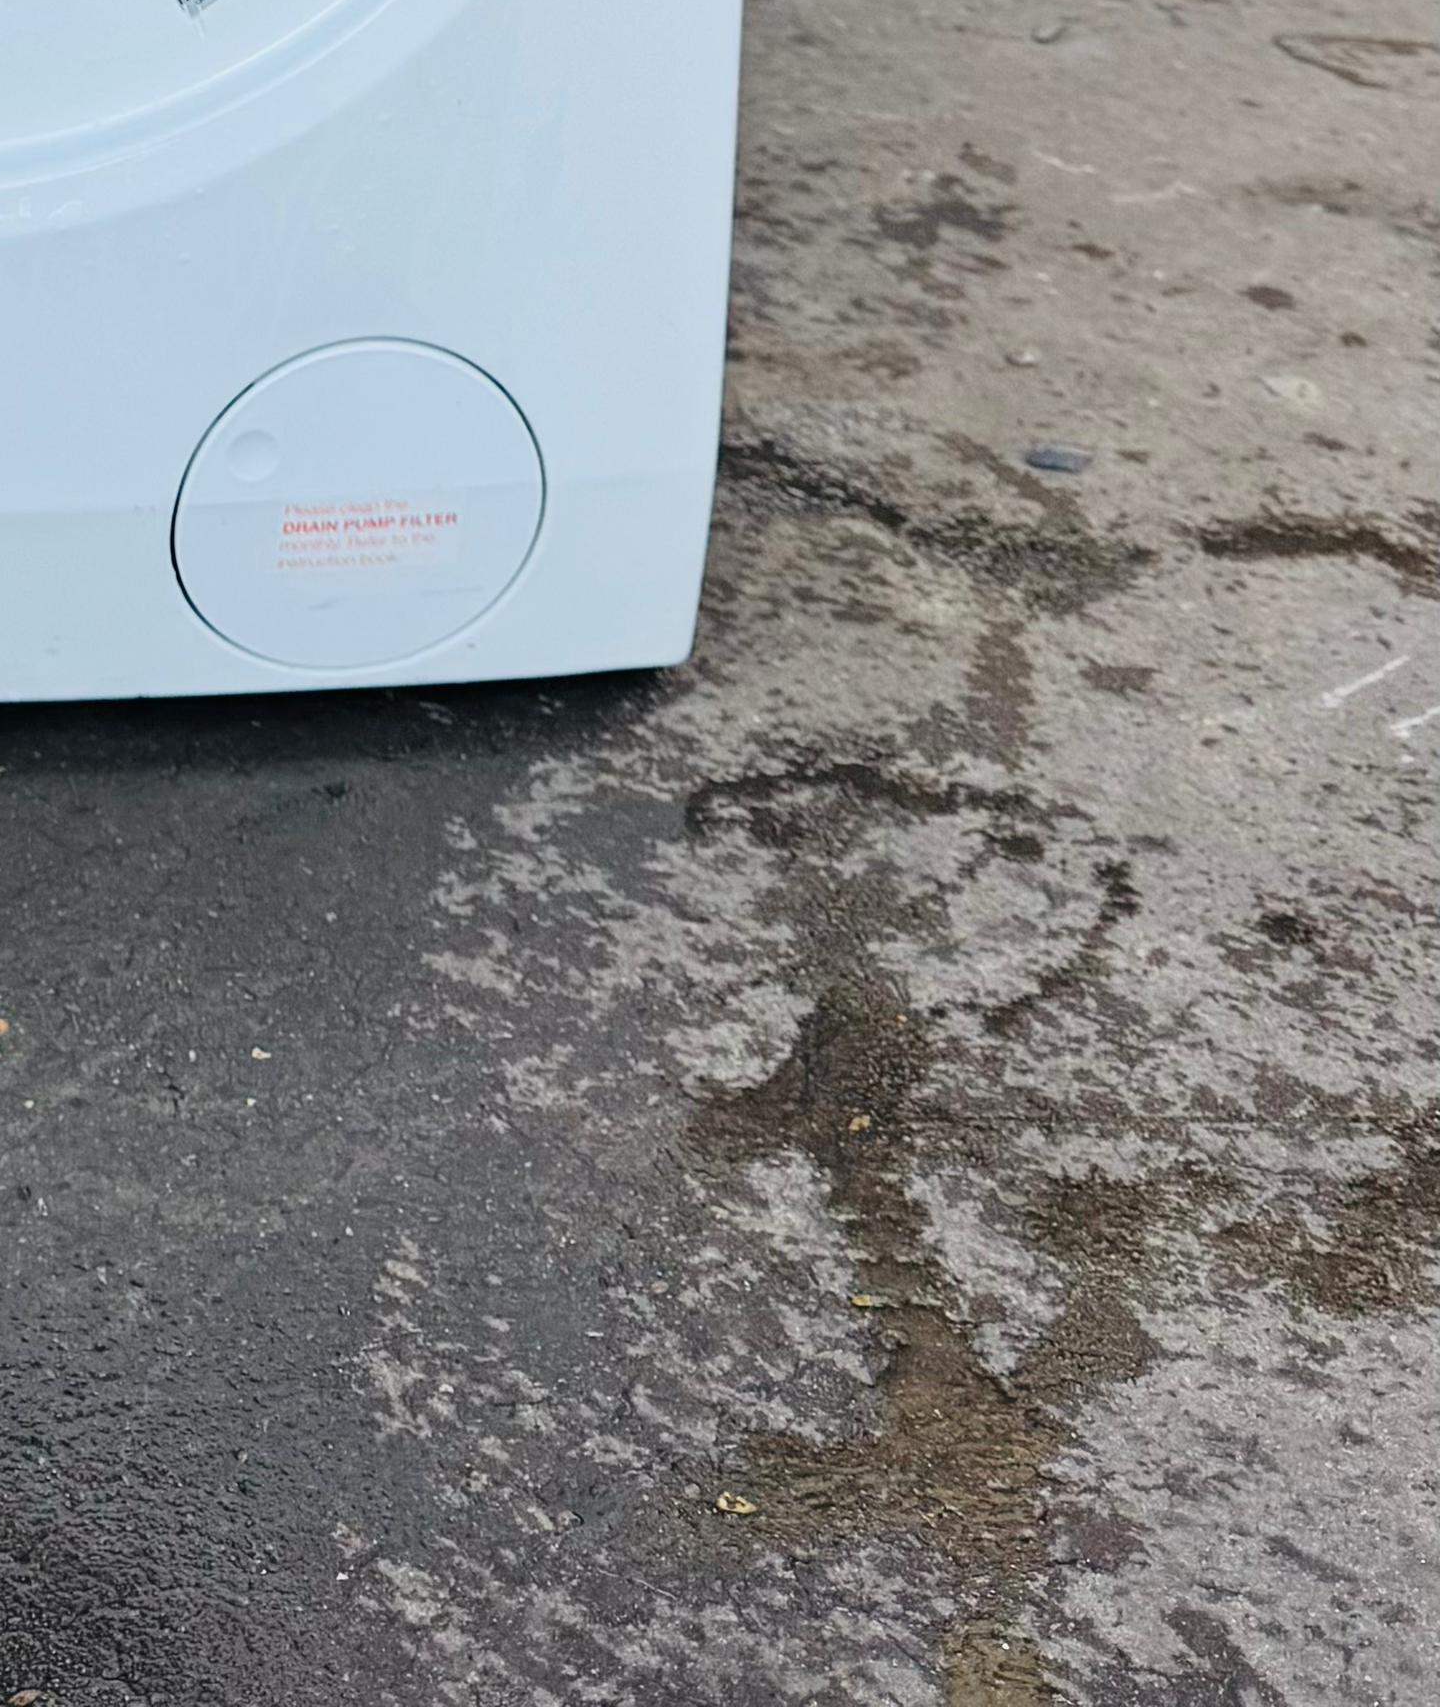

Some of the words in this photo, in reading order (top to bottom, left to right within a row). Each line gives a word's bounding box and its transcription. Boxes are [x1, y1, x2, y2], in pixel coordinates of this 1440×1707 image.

[282, 520, 338, 535] DRAIN
[343, 516, 396, 531] PUMP
[399, 512, 458, 529] FILTER
